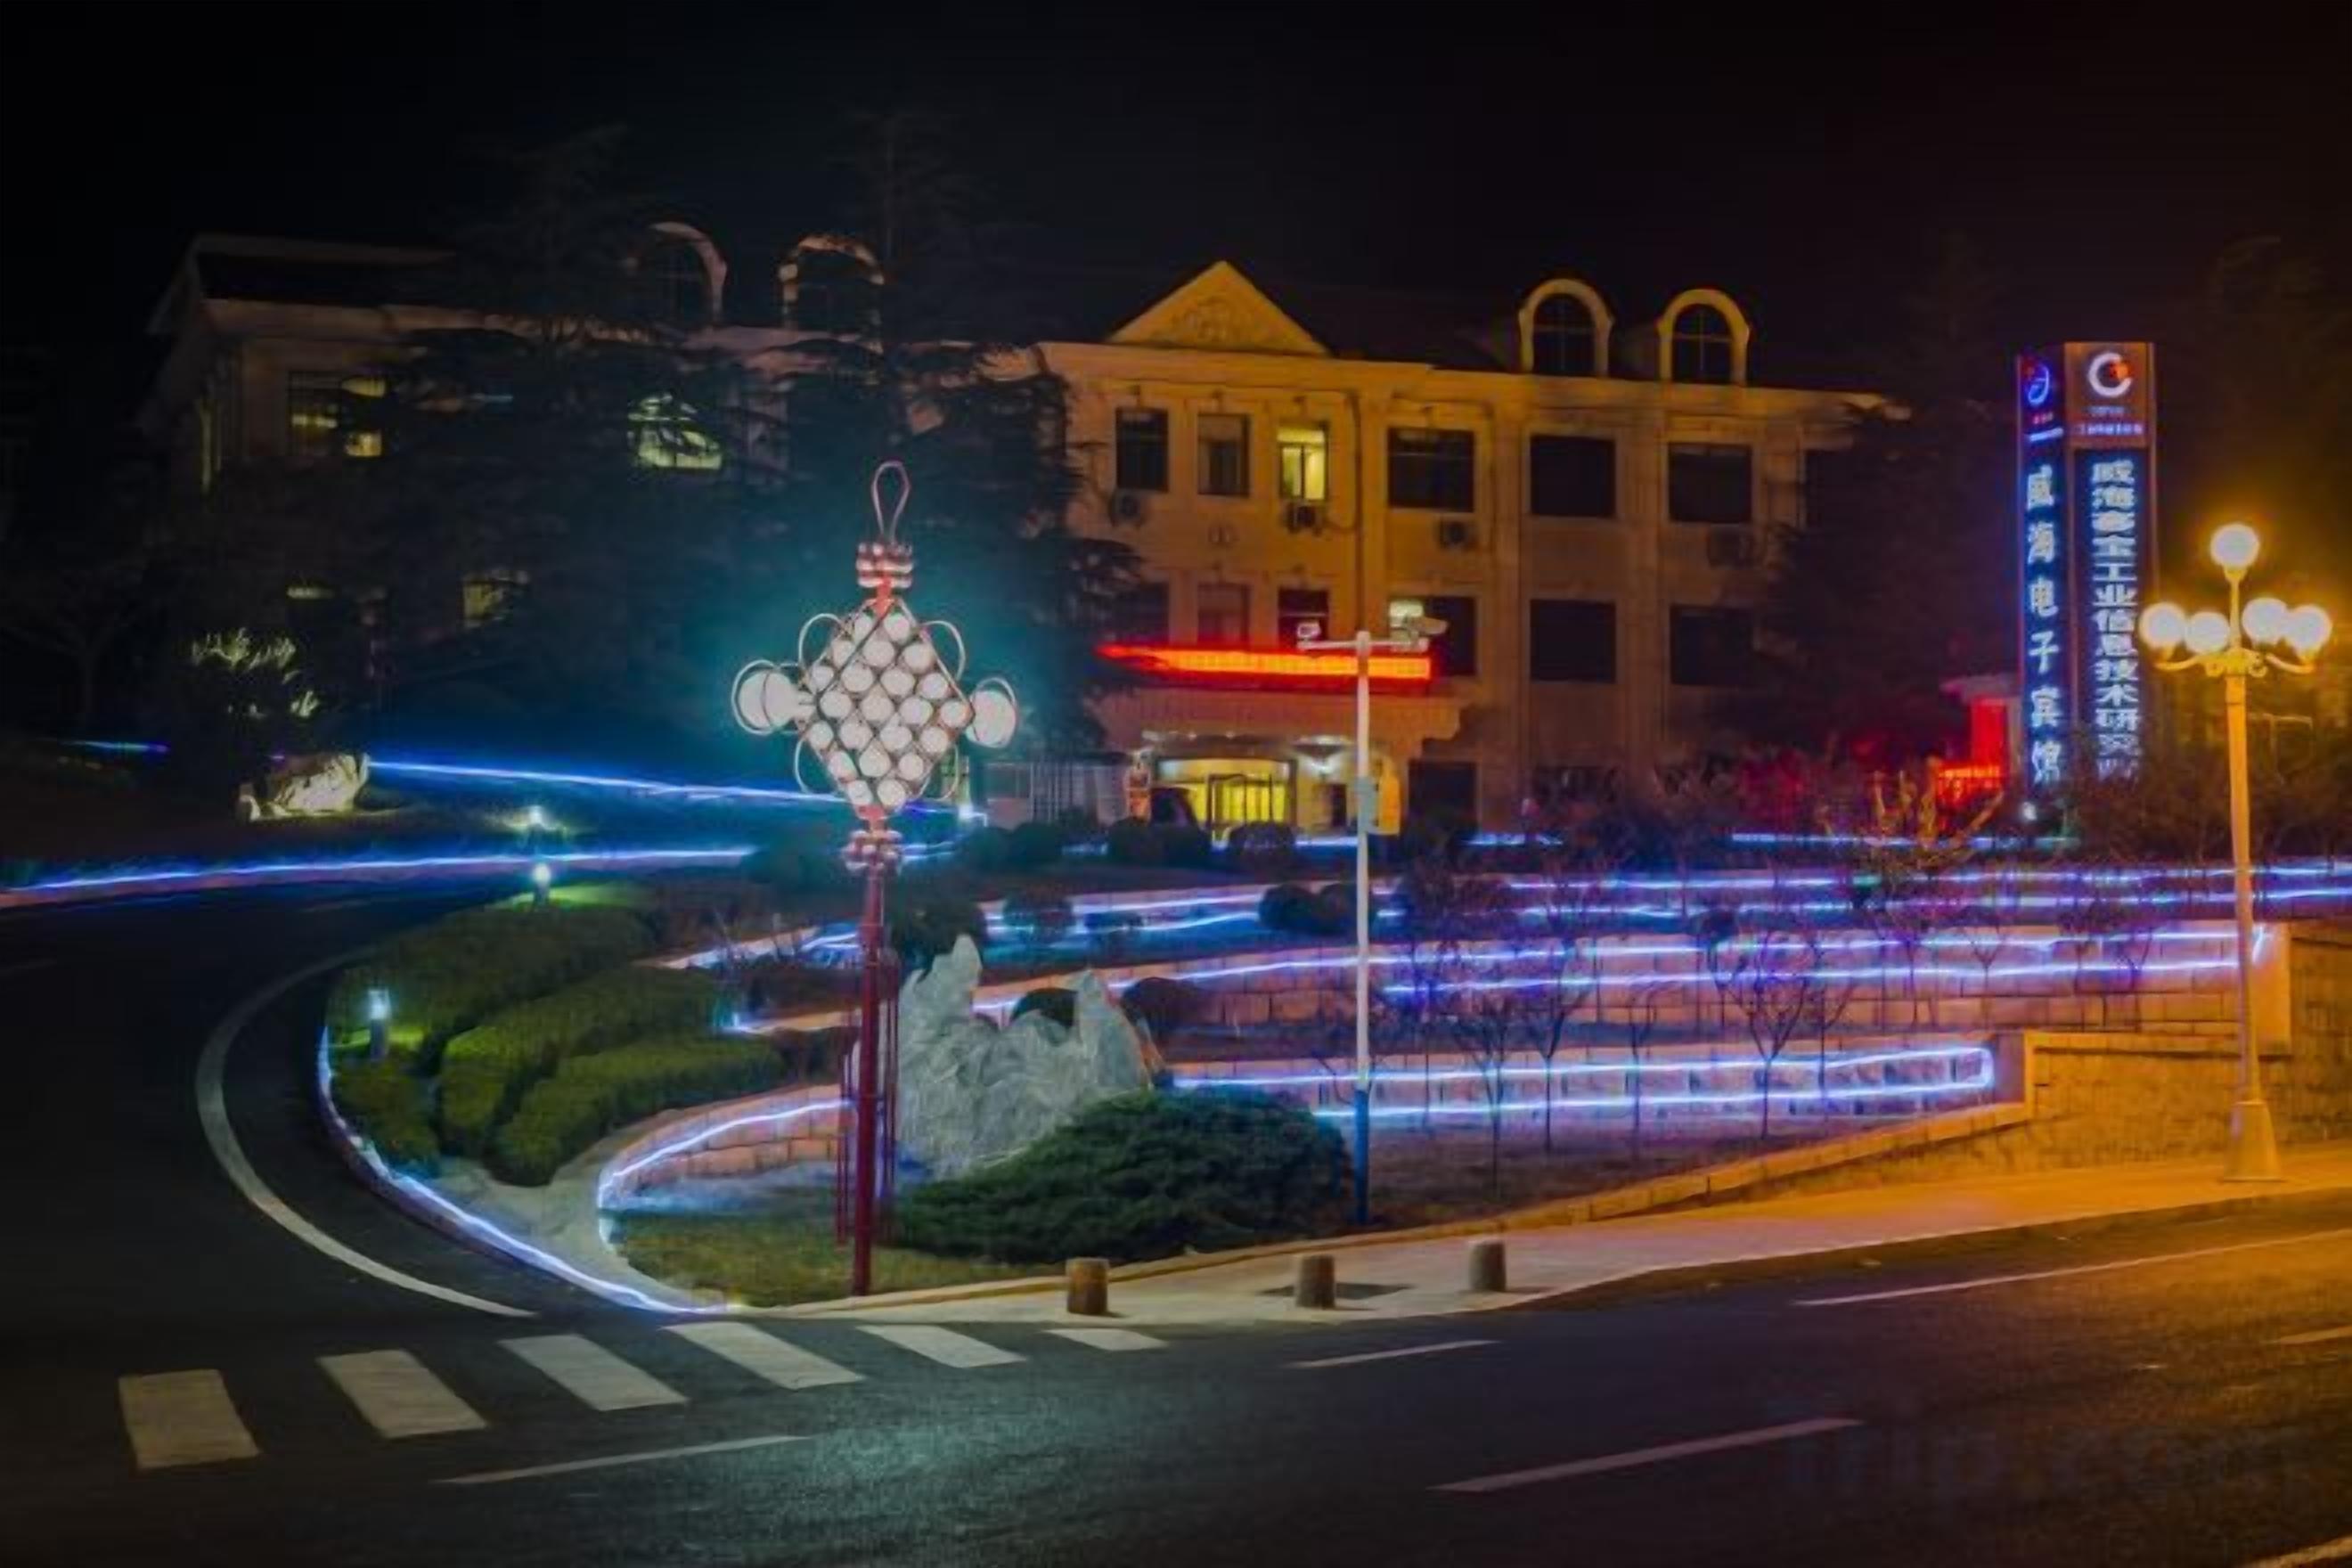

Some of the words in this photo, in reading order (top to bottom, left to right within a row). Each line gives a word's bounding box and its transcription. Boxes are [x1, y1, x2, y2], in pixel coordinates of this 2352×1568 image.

[2026, 464, 2062, 785] 威海电子宾馆
